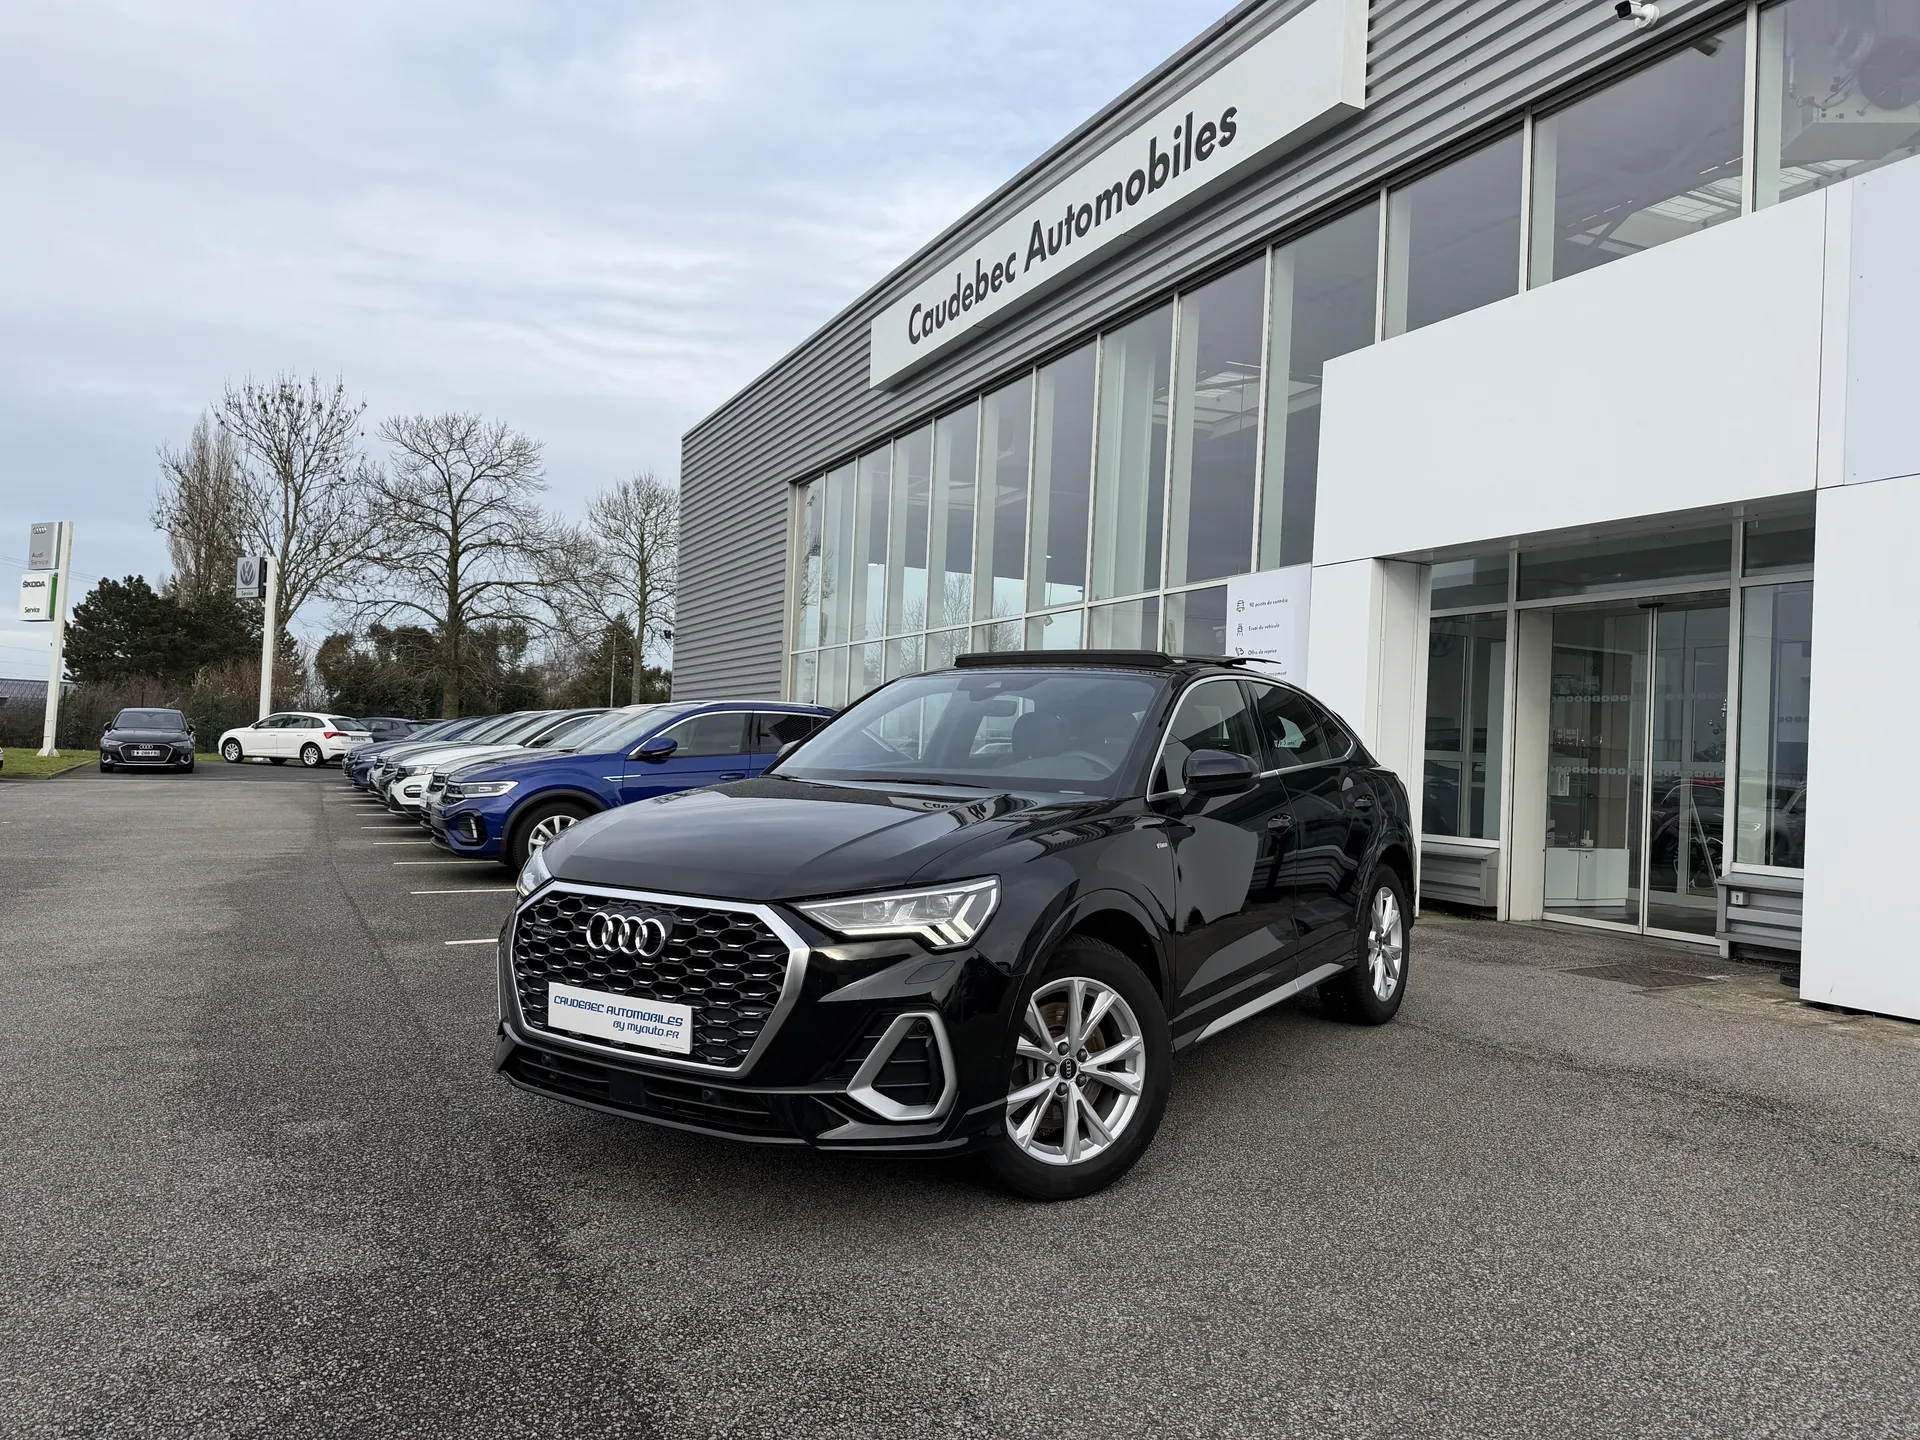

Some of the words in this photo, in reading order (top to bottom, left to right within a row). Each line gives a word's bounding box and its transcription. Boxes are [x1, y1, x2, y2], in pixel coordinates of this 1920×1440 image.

[908, 252, 1017, 345] Caudebec
[1023, 106, 1238, 274] Automobiles
[24, 606, 40, 614] Service
[553, 995, 605, 1014] CAUDEBEC
[606, 1005, 684, 1027] AUTOMOBILES
[612, 1020, 626, 1032] By
